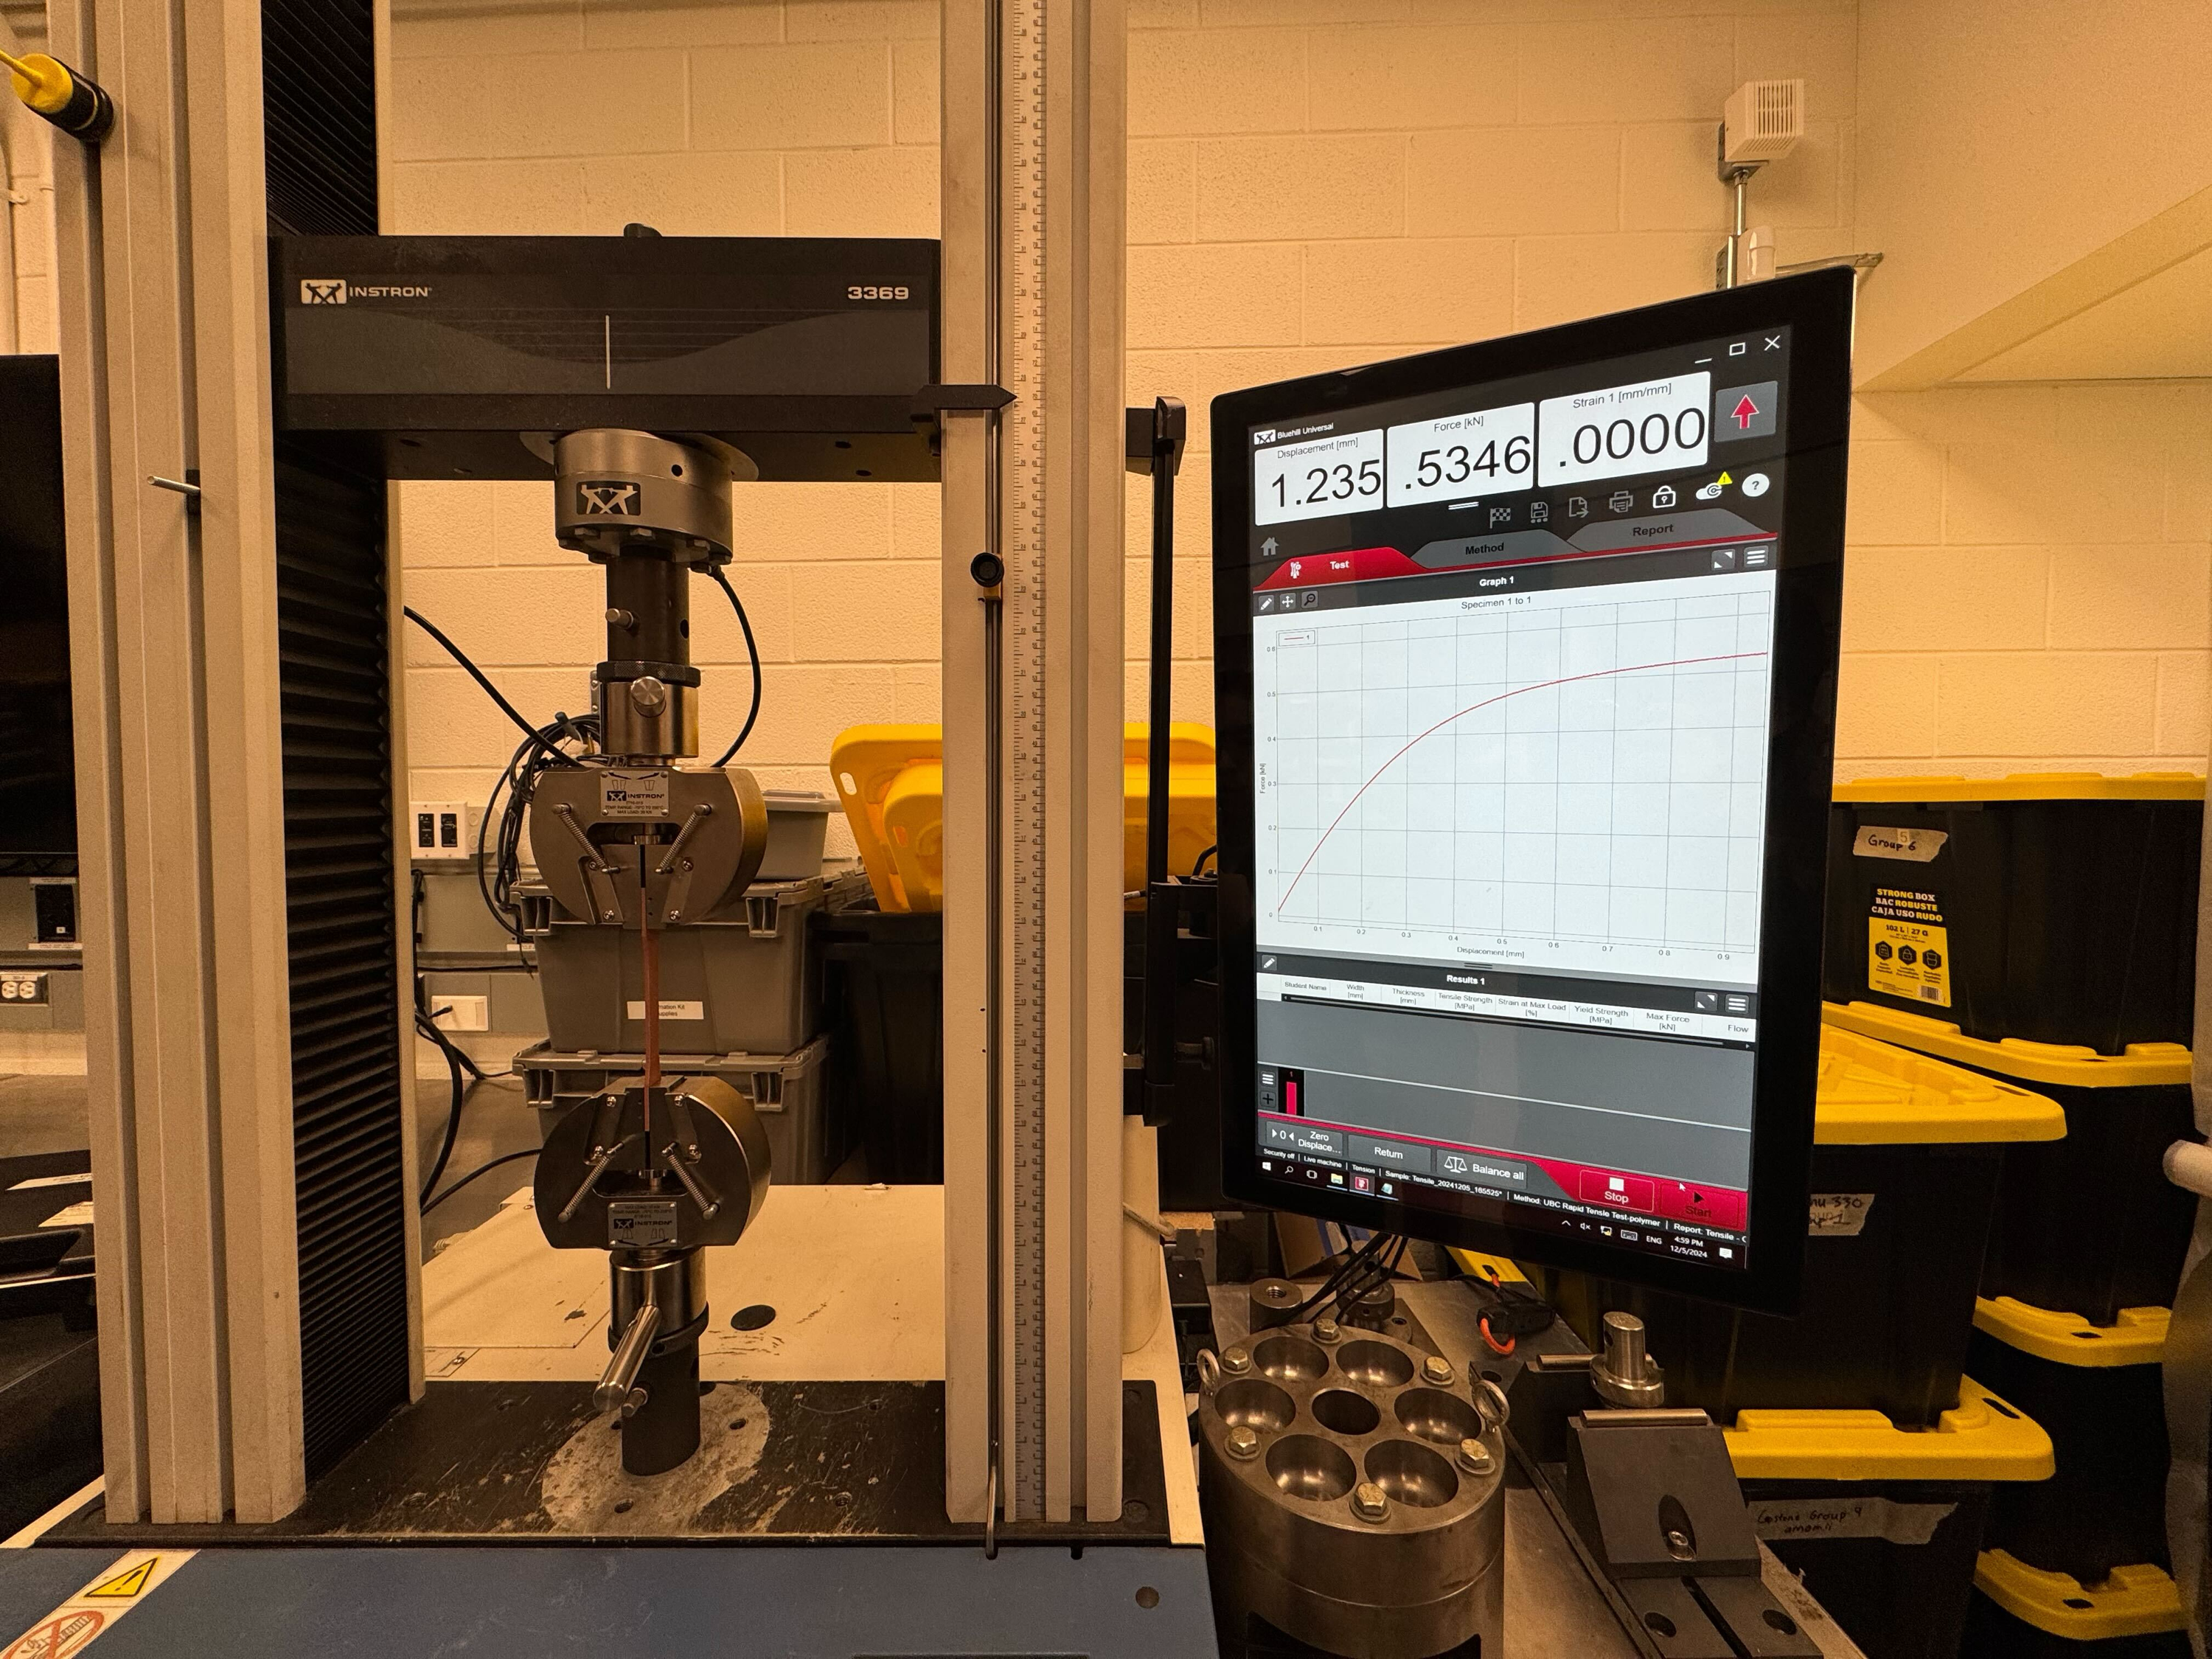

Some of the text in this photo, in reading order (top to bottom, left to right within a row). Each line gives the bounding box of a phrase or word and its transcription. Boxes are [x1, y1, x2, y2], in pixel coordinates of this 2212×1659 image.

[349, 287, 428, 297] INSTRON
[848, 287, 908, 299] 3369
[1573, 383, 1672, 408] Strain 1 [mm/mm]
[1434, 416, 1484, 432] Force [kN]
[1277, 422, 1334, 439] Bluehill Universal
[1559, 408, 1705, 467] .0000
[1277, 437, 1358, 459] Displacement [mm]
[1405, 436, 1531, 490] .5346
[1272, 459, 1381, 507] 1.235
[1632, 524, 1674, 537] Report
[1465, 543, 1504, 555] Method
[1329, 560, 1349, 570] Test
[1479, 576, 1514, 588] Graph 1
[1461, 597, 1502, 611] Specimen
[1514, 596, 1523, 604] to
[1527, 596, 1531, 604] 1
[1868, 835, 1916, 851] Group 6
[1877, 888, 1935, 902] STRONG BOX
[1876, 897, 1938, 911] BAC ROBUSTE
[1871, 906, 1943, 922] CAJA USO RUDO
[1457, 947, 1525, 959] Displacement [mm]
[1446, 975, 1478, 984] Results
[1392, 988, 1425, 997] Thickness
[1439, 992, 1492, 1004] Tensile Strength
[1455, 1003, 1475, 1011] [MPa]
[1498, 998, 1519, 1006] Strain
[1596, 1007, 1629, 1018] Strength
[1646, 1012, 1689, 1023] Max Force
[1589, 1016, 1613, 1025] [MPa]
[1659, 1023, 1675, 1032] [kN]
[1310, 1130, 1329, 1141] Zero
[1298, 1139, 1341, 1154] Displace...
[1264, 1148, 1286, 1158] Security
[1374, 1147, 1403, 1159] Return
[1304, 1155, 1342, 1167] Live machine
[1352, 1164, 1375, 1174] Tension
[1472, 1164, 1524, 1180] Balance all
[1604, 1191, 1629, 1205] Stop
[1514, 1194, 1541, 1205] Method:
[1544, 1200, 1560, 1208] UBC
[1562, 1203, 1584, 1212] Rapid
[1611, 1211, 1660, 1226] Test-polymer
[1686, 1205, 1711, 1218] Start
[1674, 1223, 1703, 1234] Report:
[1705, 1228, 1734, 1240] Tensile
[1646, 1236, 1662, 1245] ENG
[1674, 1236, 1703, 1247] 4:59 PM
[1670, 1245, 1708, 1258] 12/5/2024
[1809, 1510, 1846, 1523] Group
